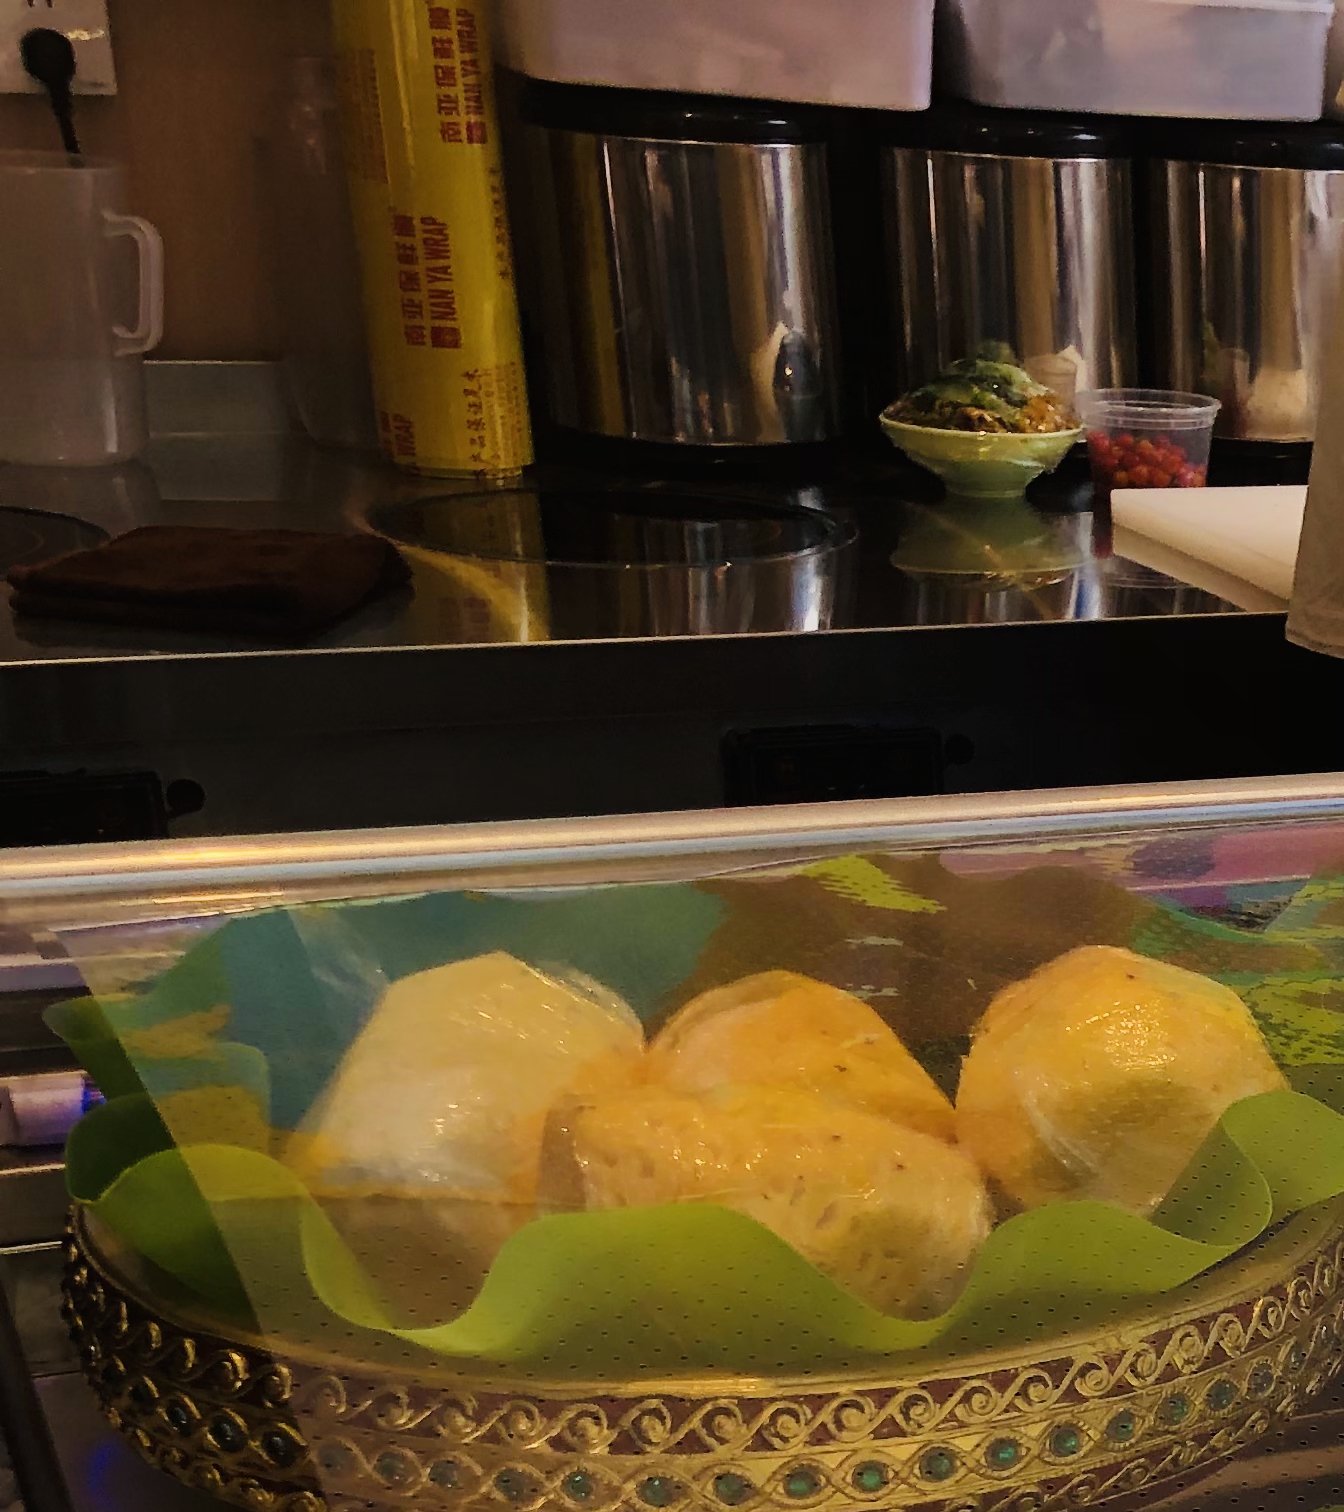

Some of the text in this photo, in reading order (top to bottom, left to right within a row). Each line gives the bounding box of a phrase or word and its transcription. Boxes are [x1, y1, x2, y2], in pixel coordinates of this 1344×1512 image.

[455, 8, 485, 116] NAN YA WRAP
[419, 216, 458, 322] NAN YA WRAP
